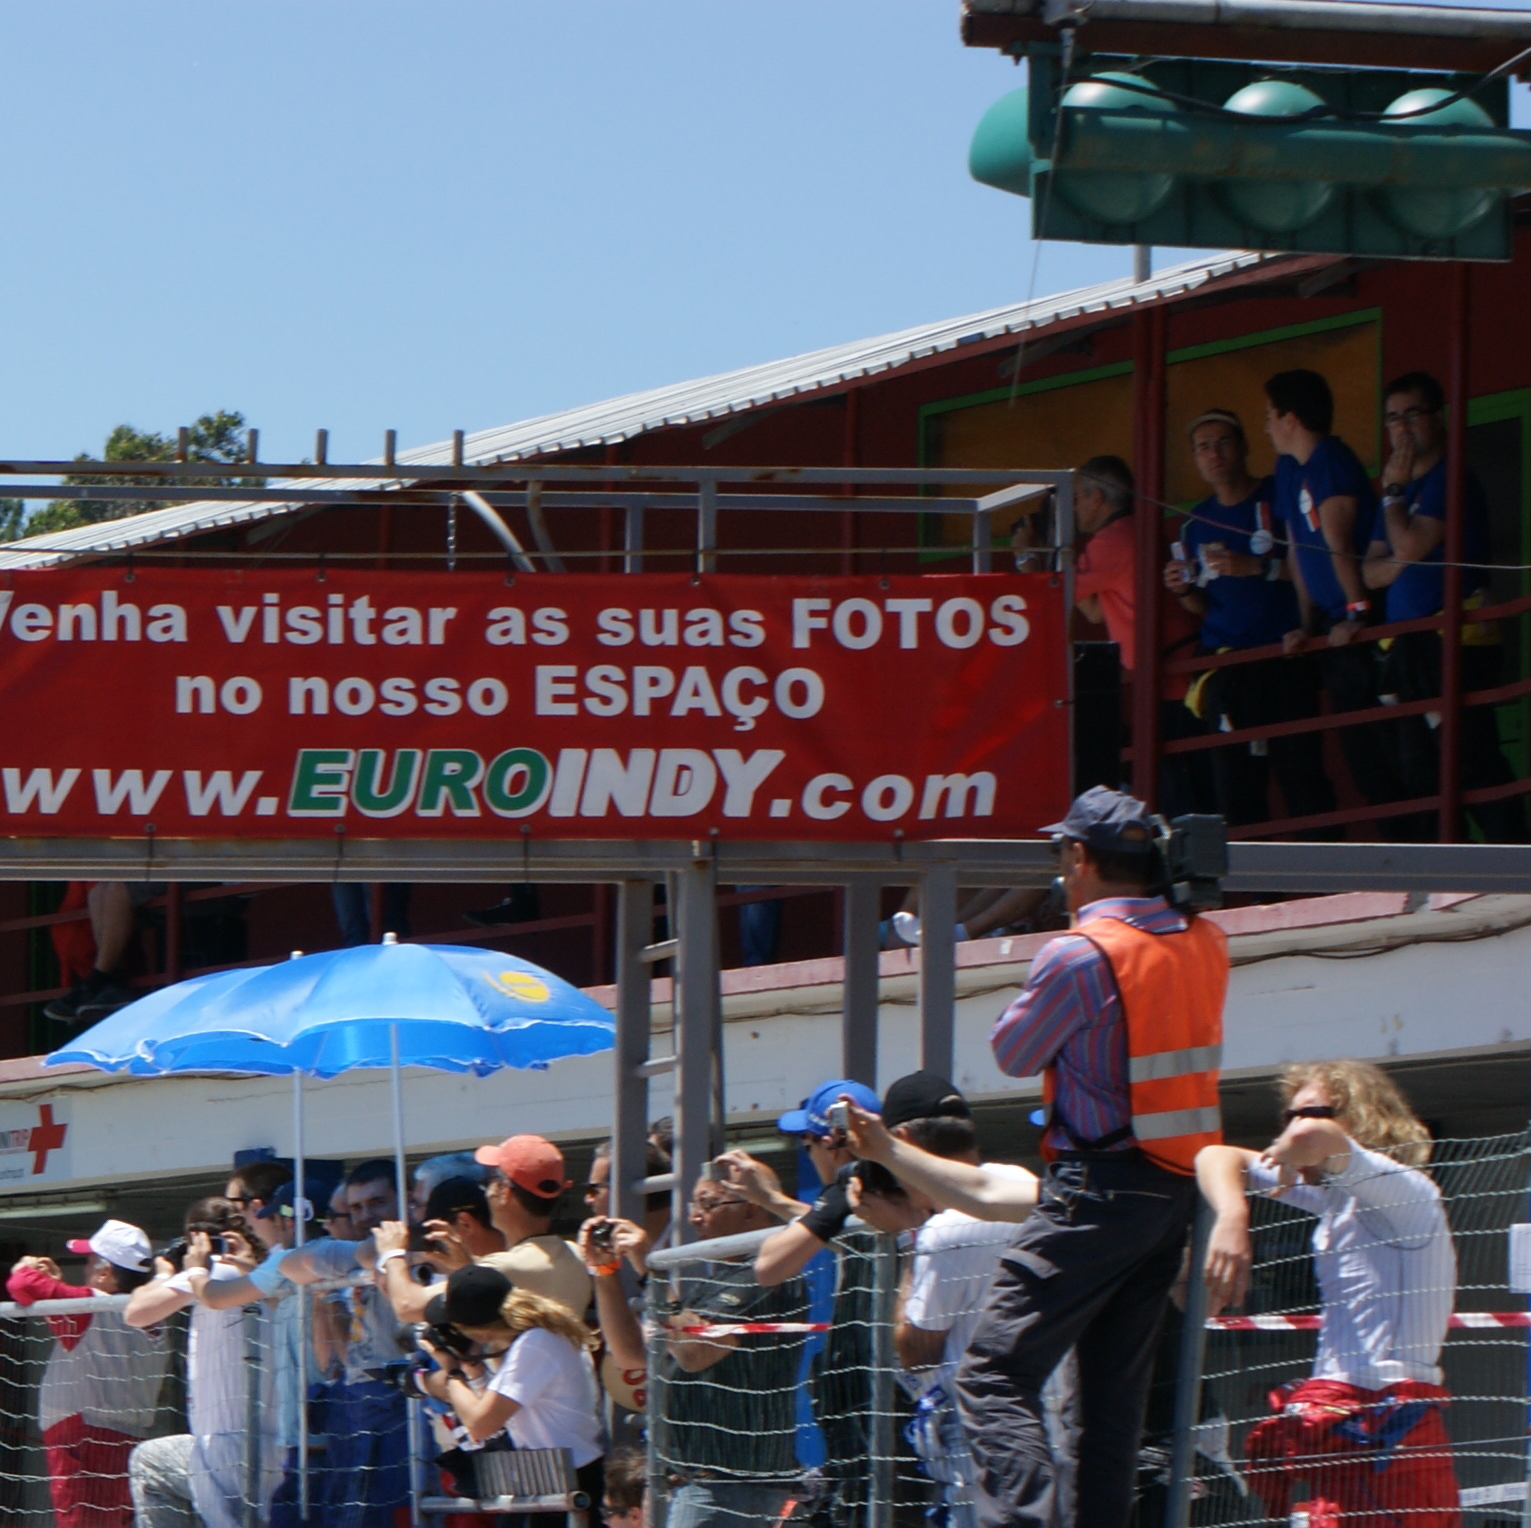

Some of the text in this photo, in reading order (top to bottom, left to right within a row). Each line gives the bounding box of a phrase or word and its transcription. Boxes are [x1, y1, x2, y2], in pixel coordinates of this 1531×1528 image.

[216, 593, 457, 646] visitar
[485, 606, 570, 646] as
[597, 606, 766, 648] suas
[792, 594, 1030, 650] FOTOS
[175, 663, 825, 731] no nosso ESPAÇO
[1, 747, 997, 821] www.EUROINDY.com
